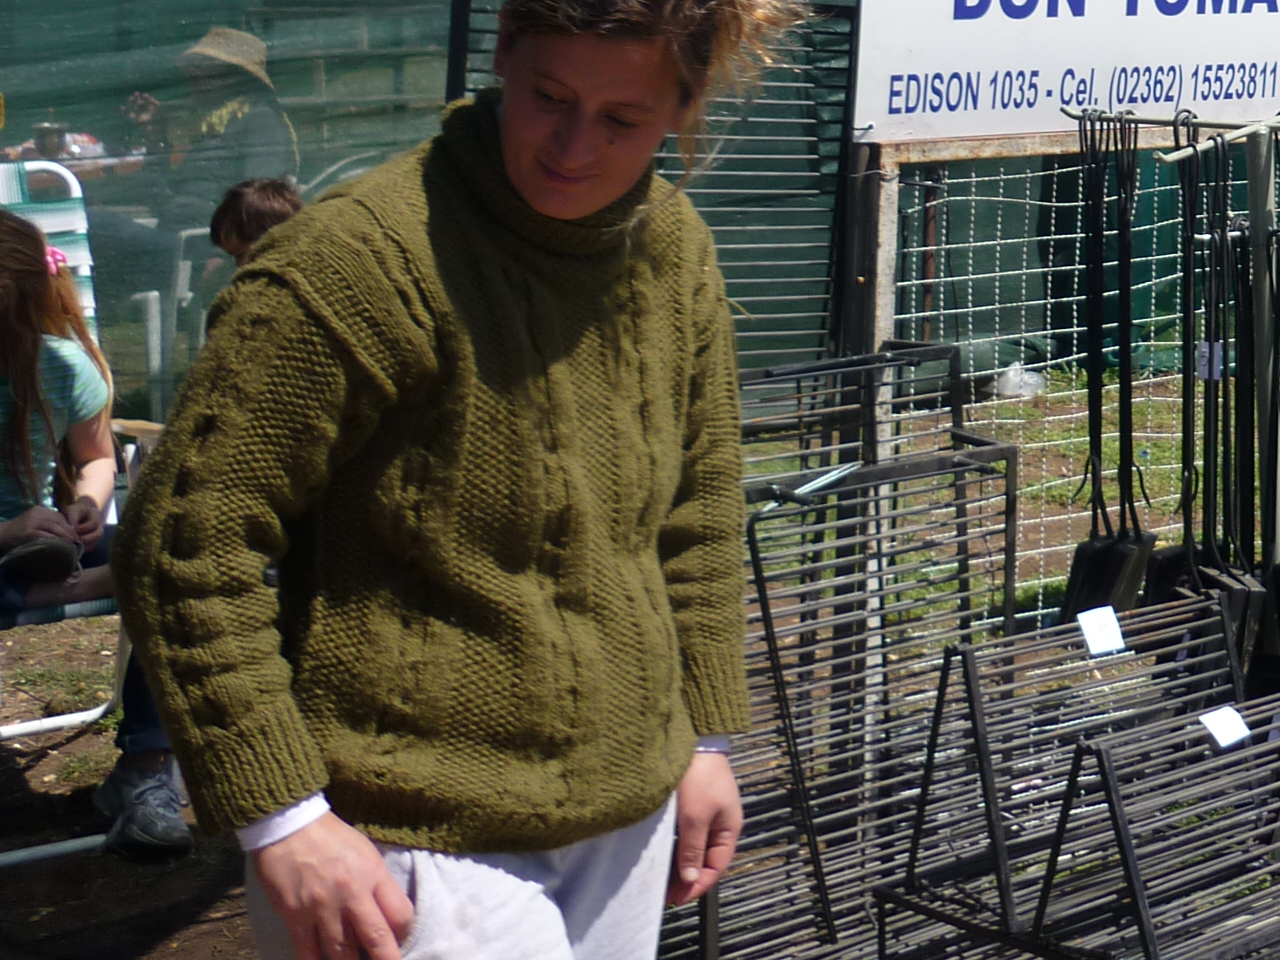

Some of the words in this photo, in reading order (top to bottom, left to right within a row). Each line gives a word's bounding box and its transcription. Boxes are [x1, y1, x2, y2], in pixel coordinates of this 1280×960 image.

[887, 71, 981, 116] EDISON
[989, 69, 1040, 110] 1035
[1059, 67, 1099, 112] Cel.
[1108, 64, 1183, 114] (02362)
[1191, 61, 1278, 102] 15523811
